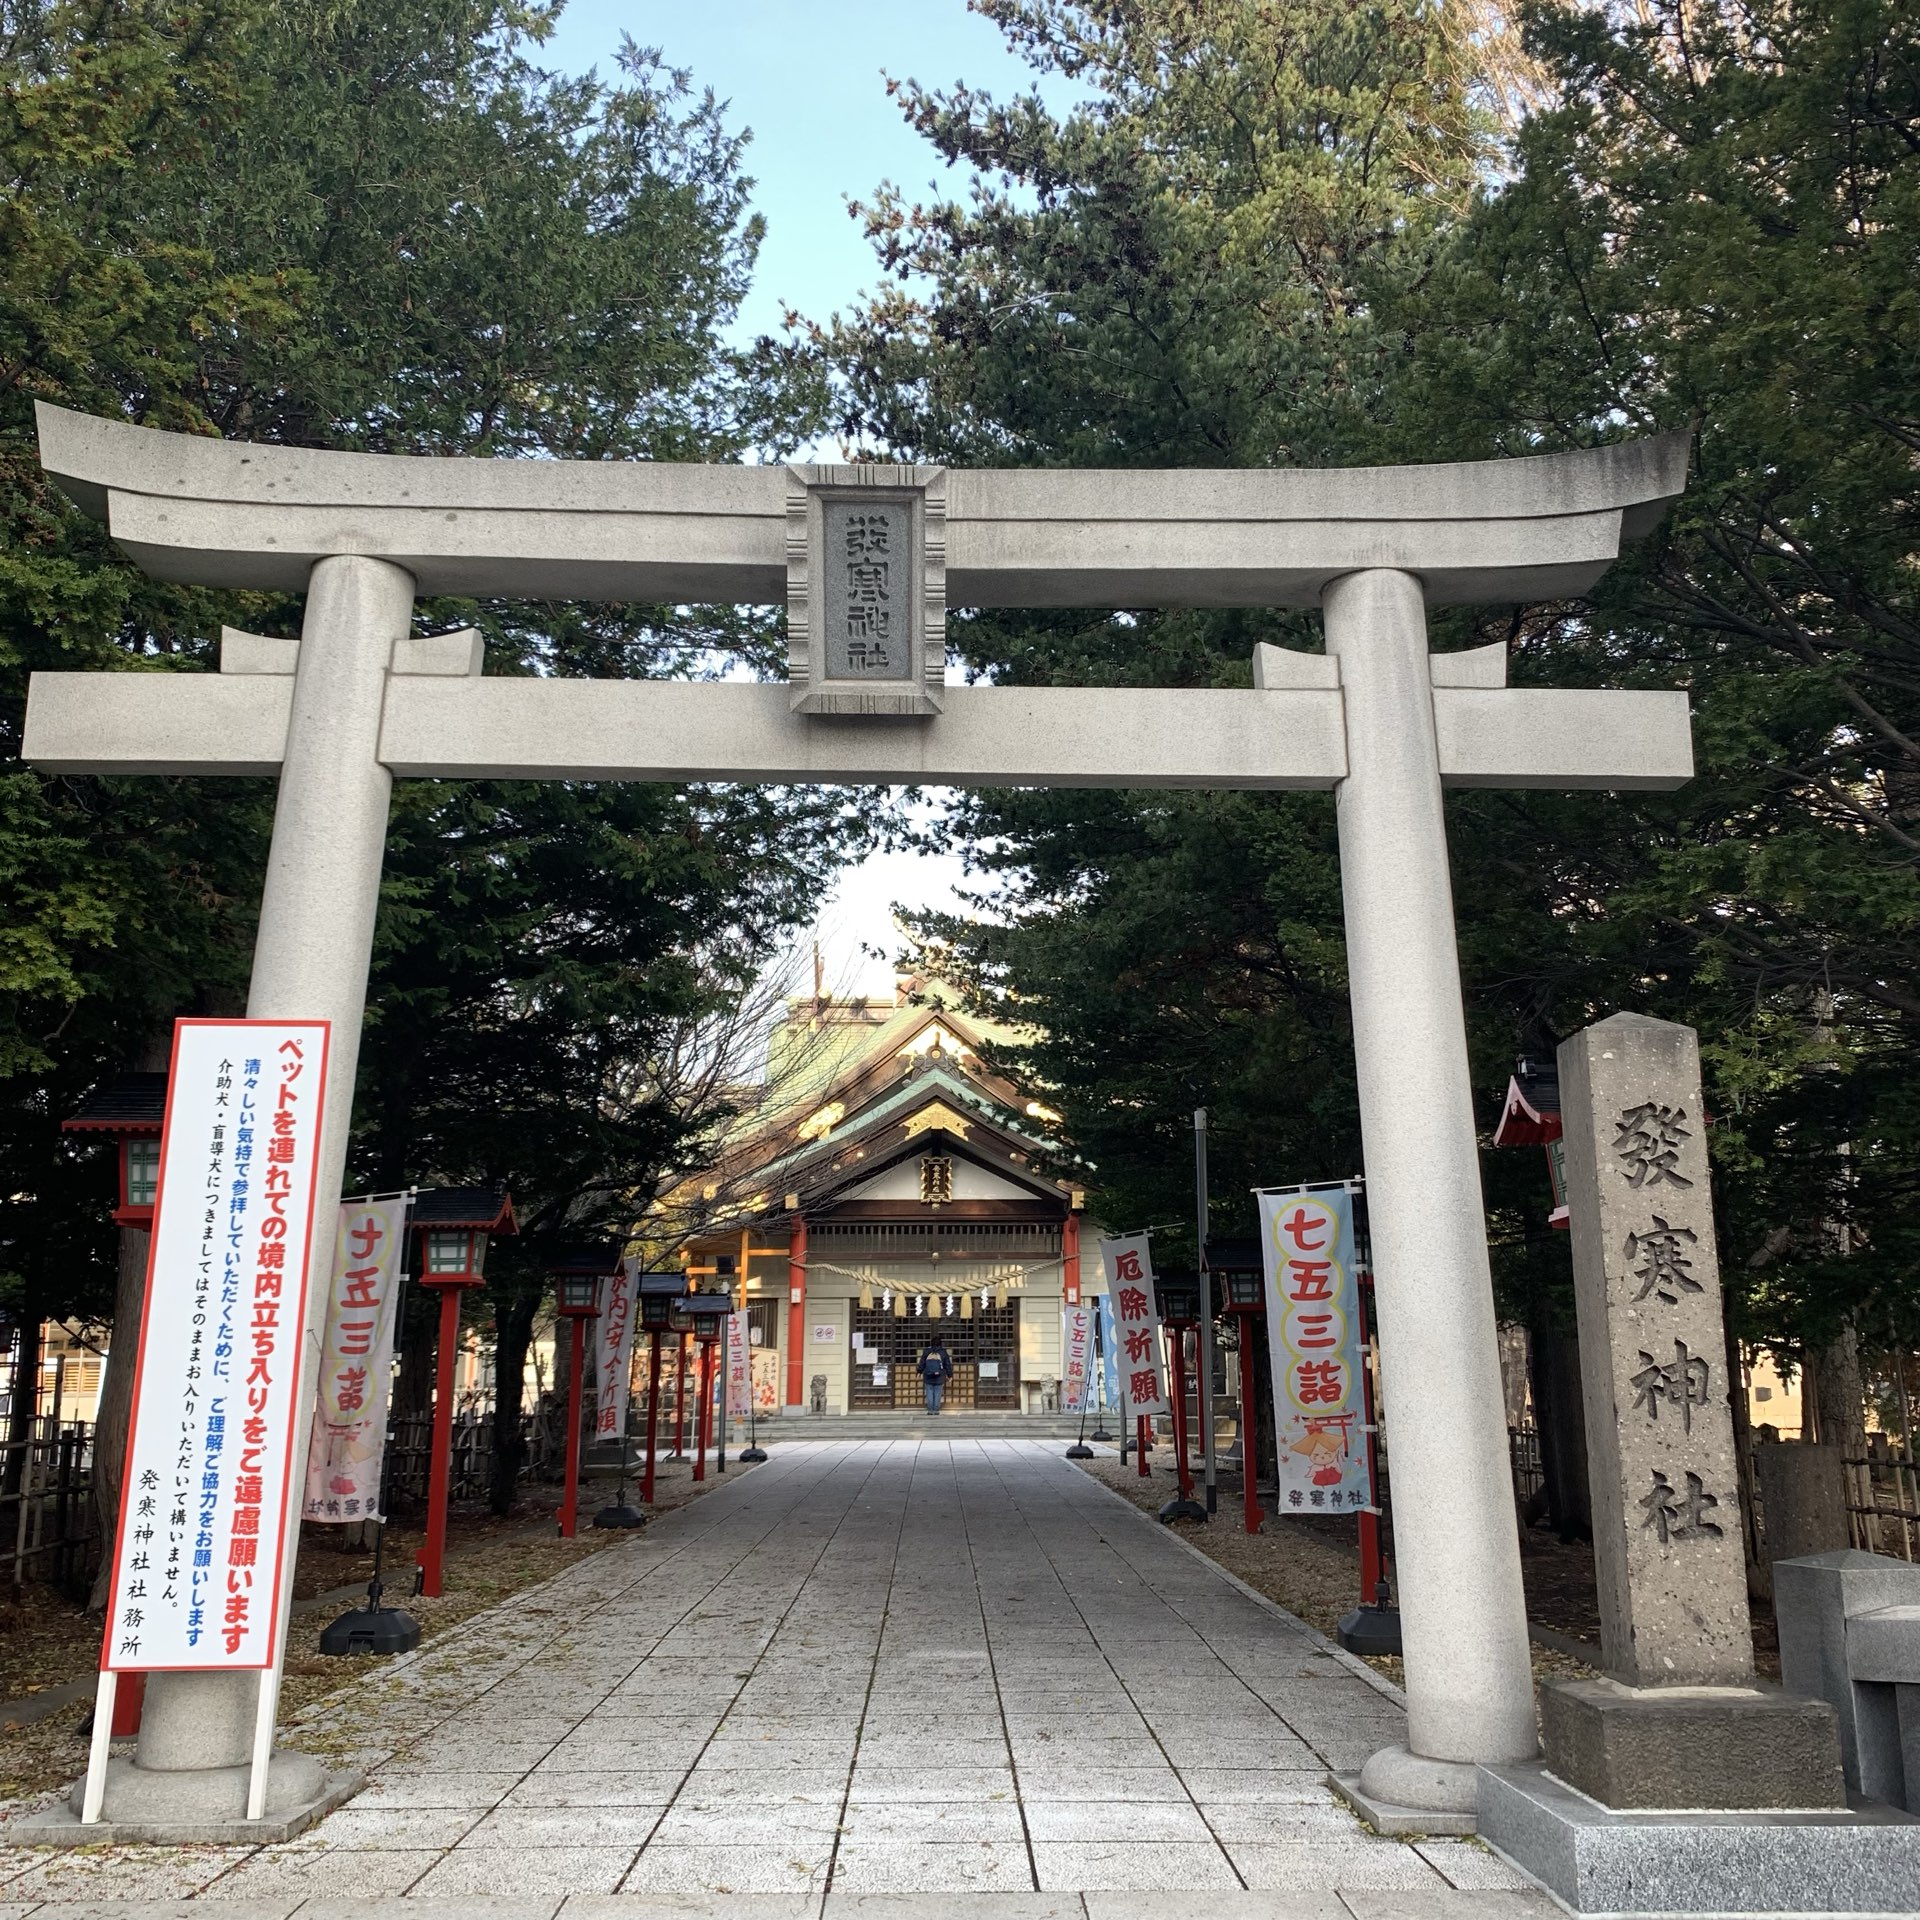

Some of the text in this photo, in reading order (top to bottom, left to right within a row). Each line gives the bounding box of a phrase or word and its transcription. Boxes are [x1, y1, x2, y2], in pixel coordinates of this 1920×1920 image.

[162, 1058, 233, 1608] 介助犬・盲導犬につきましてはそのままお入りいただいて構いません。
[186, 1058, 261, 1647] 清々しい気持で参拝していただくために、ご理解ご協力をお願いします
[221, 1038, 304, 1655] ペットを連れての境内立ち入りをご遠慮願います
[1068, 1312, 1087, 1376] 七五三詣
[1115, 1250, 1160, 1405] 厄除祈願
[1284, 1208, 1342, 1405] 七五三詣
[1612, 1101, 1723, 1544] 發寒神社
[119, 1469, 160, 1656] 発寒神社社務所
[1288, 1489, 1364, 1508] 発寒神社
